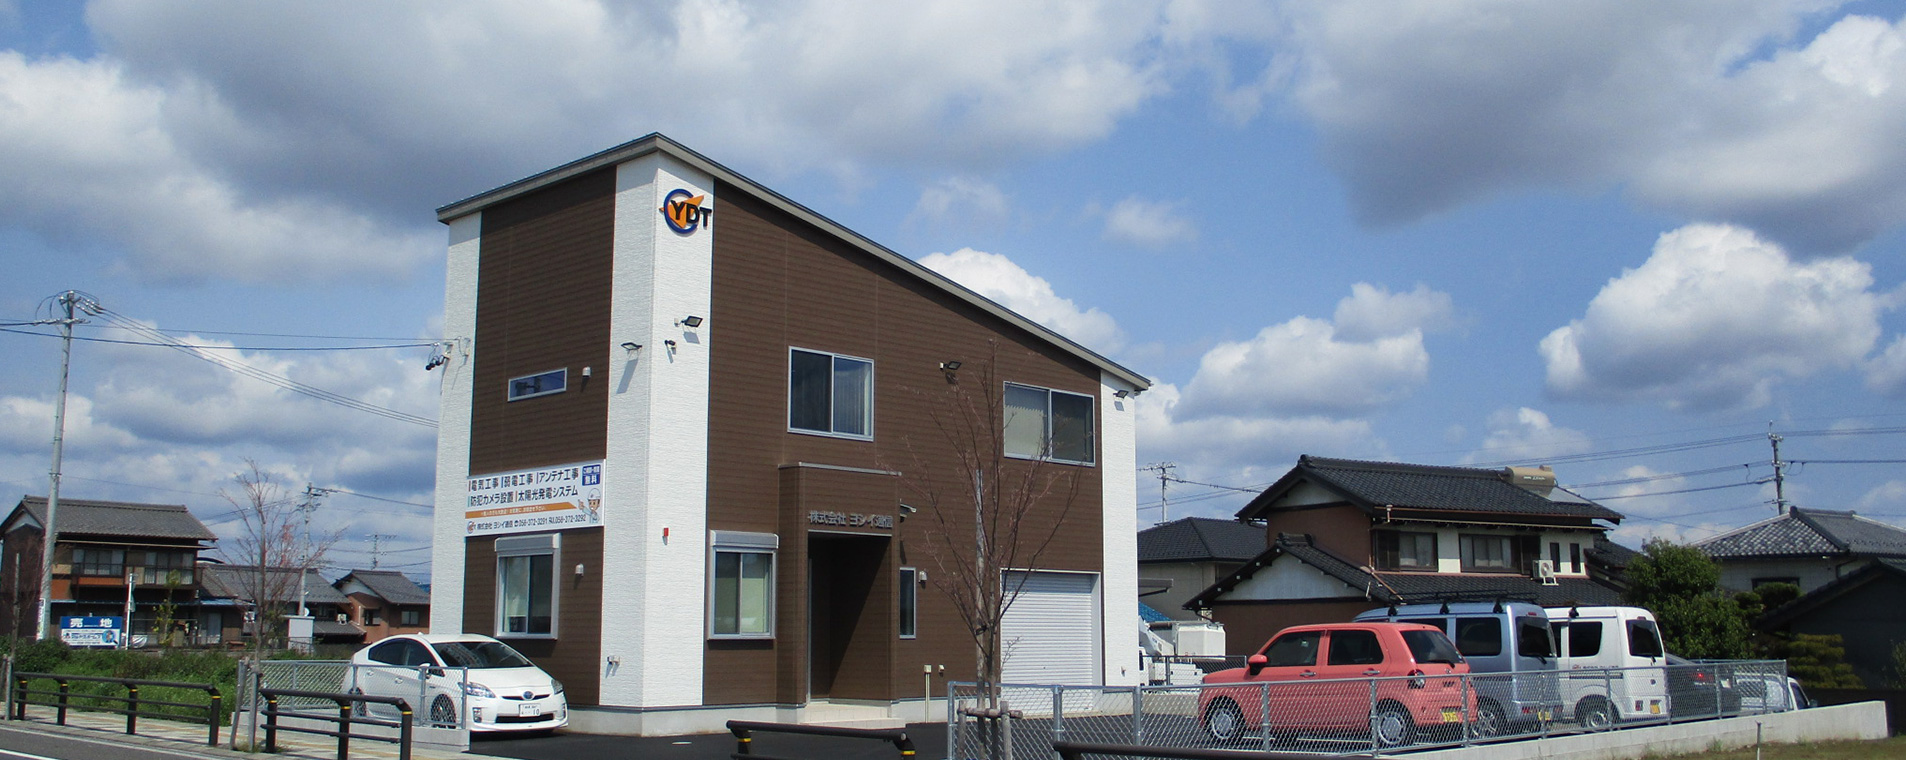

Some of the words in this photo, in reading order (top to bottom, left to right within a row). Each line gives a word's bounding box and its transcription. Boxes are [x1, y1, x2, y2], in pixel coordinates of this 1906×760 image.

[670, 199, 712, 228] YDT
[471, 477, 499, 492] 電気工事
[539, 467, 579, 483] アンテナ工事
[470, 491, 514, 507] 防犯カメラ設置
[518, 485, 578, 502] 太陽光発電システム
[807, 510, 847, 526] 株式会社
